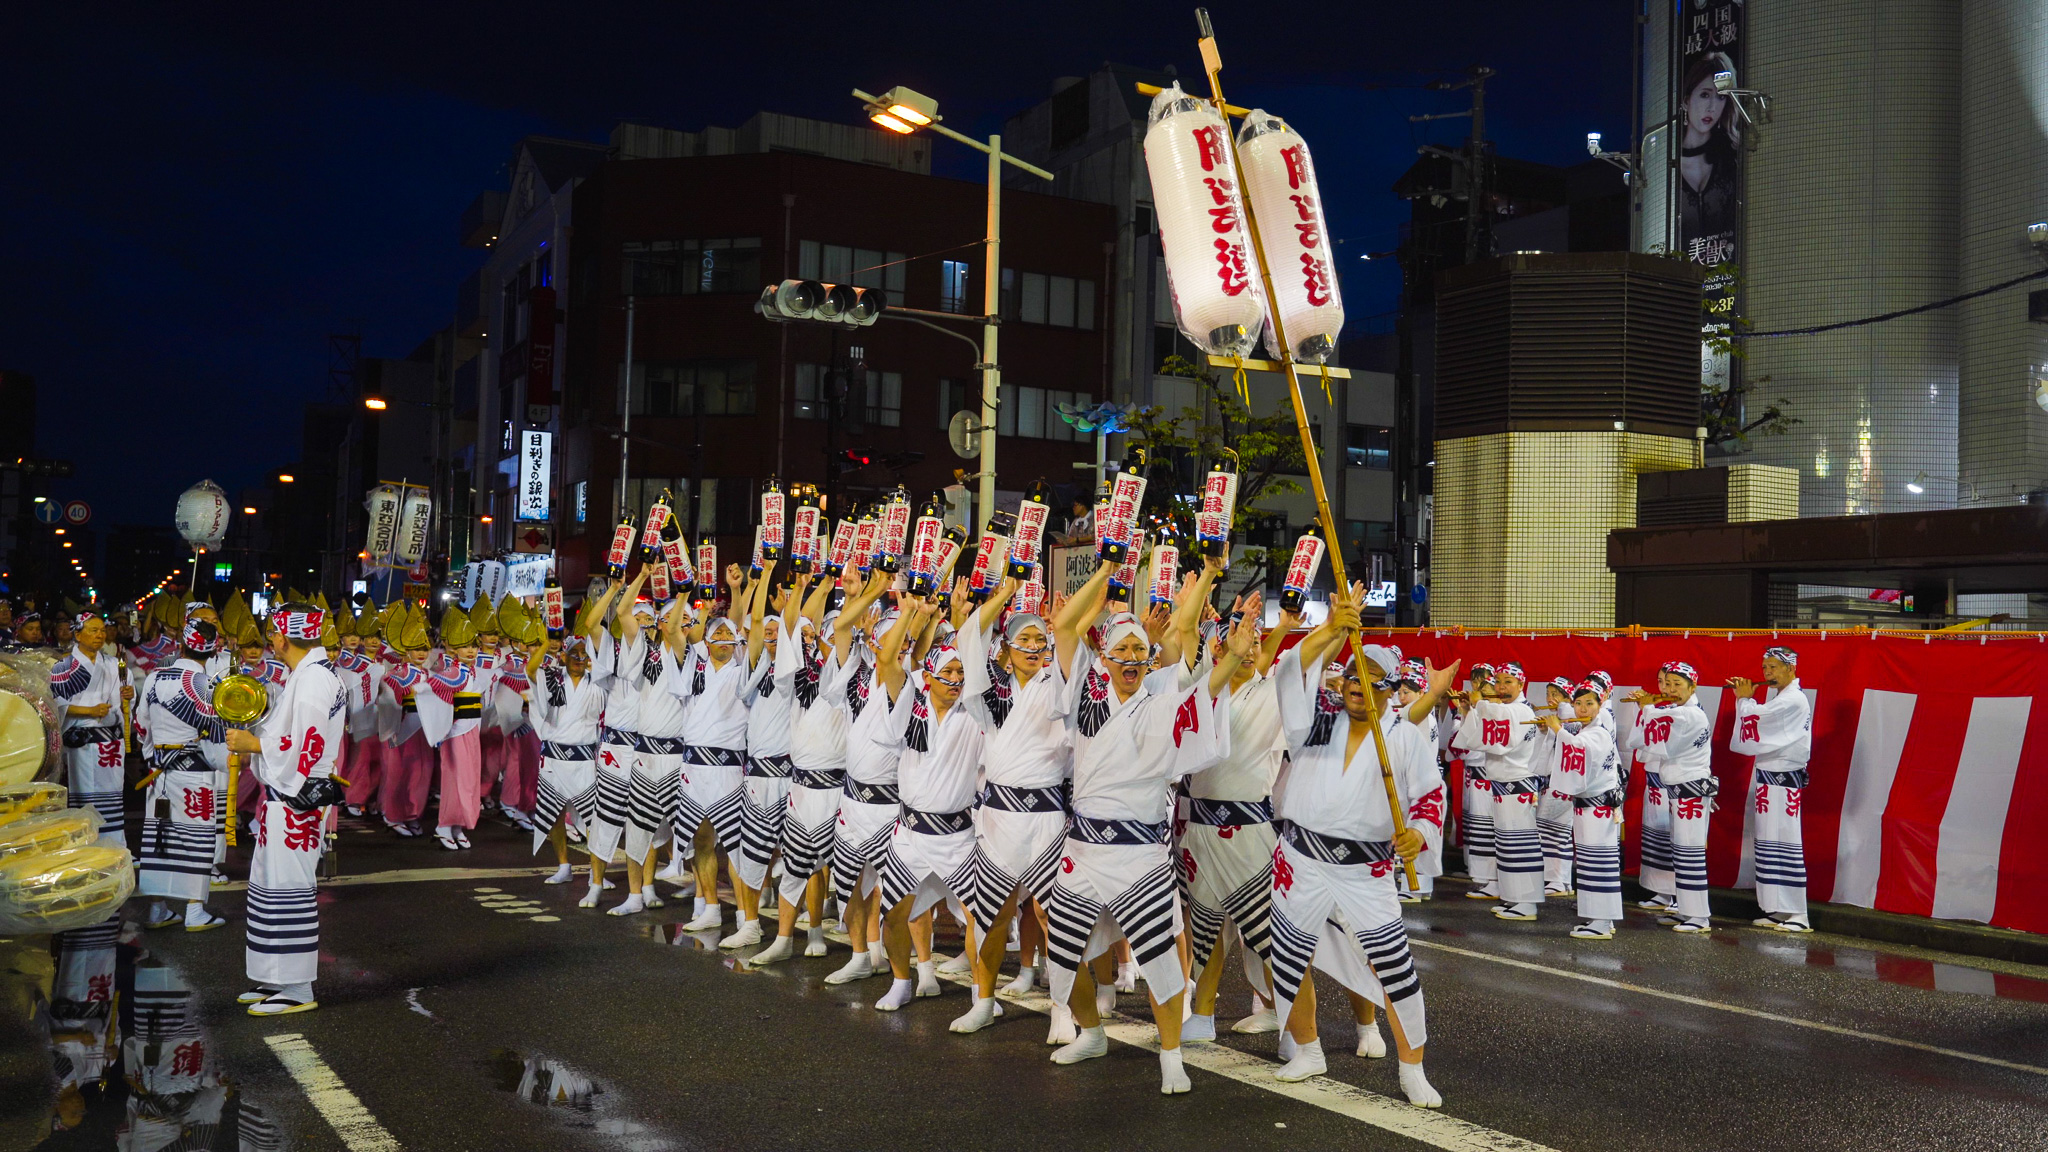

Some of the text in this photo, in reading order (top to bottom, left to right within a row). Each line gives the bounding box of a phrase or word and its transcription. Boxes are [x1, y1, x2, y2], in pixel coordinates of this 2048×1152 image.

[1693, 4, 1731, 33] 四国
[1685, 22, 1737, 55] 最大級
[531, 408, 548, 416] 4F
[528, 434, 543, 510] 目利きの銀次
[71, 508, 85, 518] 40
[374, 500, 396, 552] 東亞合成
[408, 504, 430, 555] 東亞合成
[1482, 718, 1510, 747] 阿
[1644, 716, 1674, 746] 阿
[1740, 715, 1760, 743] 阿
[97, 741, 123, 768] 呆
[1561, 742, 1586, 776] 阿
[183, 786, 215, 821] 連
[284, 806, 321, 852] 呆
